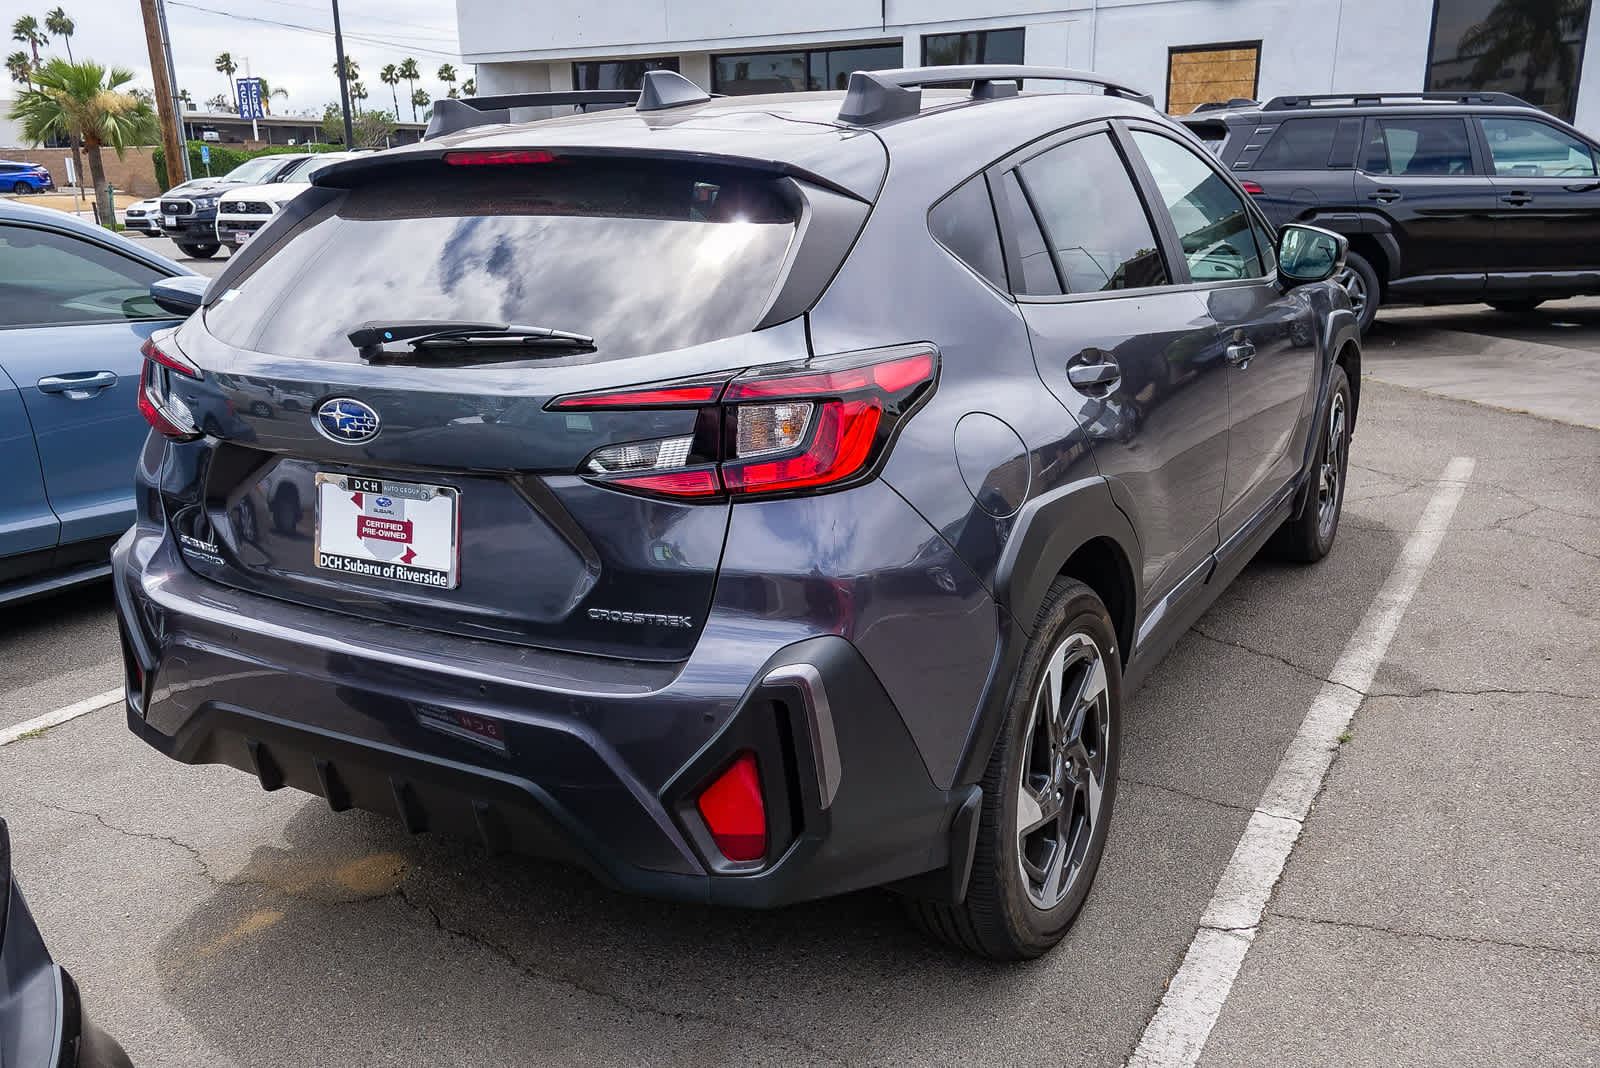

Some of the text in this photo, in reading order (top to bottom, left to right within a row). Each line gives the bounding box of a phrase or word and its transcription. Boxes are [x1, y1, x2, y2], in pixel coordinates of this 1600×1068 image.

[240, 84, 250, 118] ACURA
[251, 84, 261, 117] ACURA
[383, 485, 399, 493] AUTO
[362, 527, 407, 540] PRE-OWNED
[365, 519, 403, 531] CERTIFIED
[320, 554, 447, 586] DCH Subaru of Riverside
[587, 608, 692, 628] CROSSTREK
